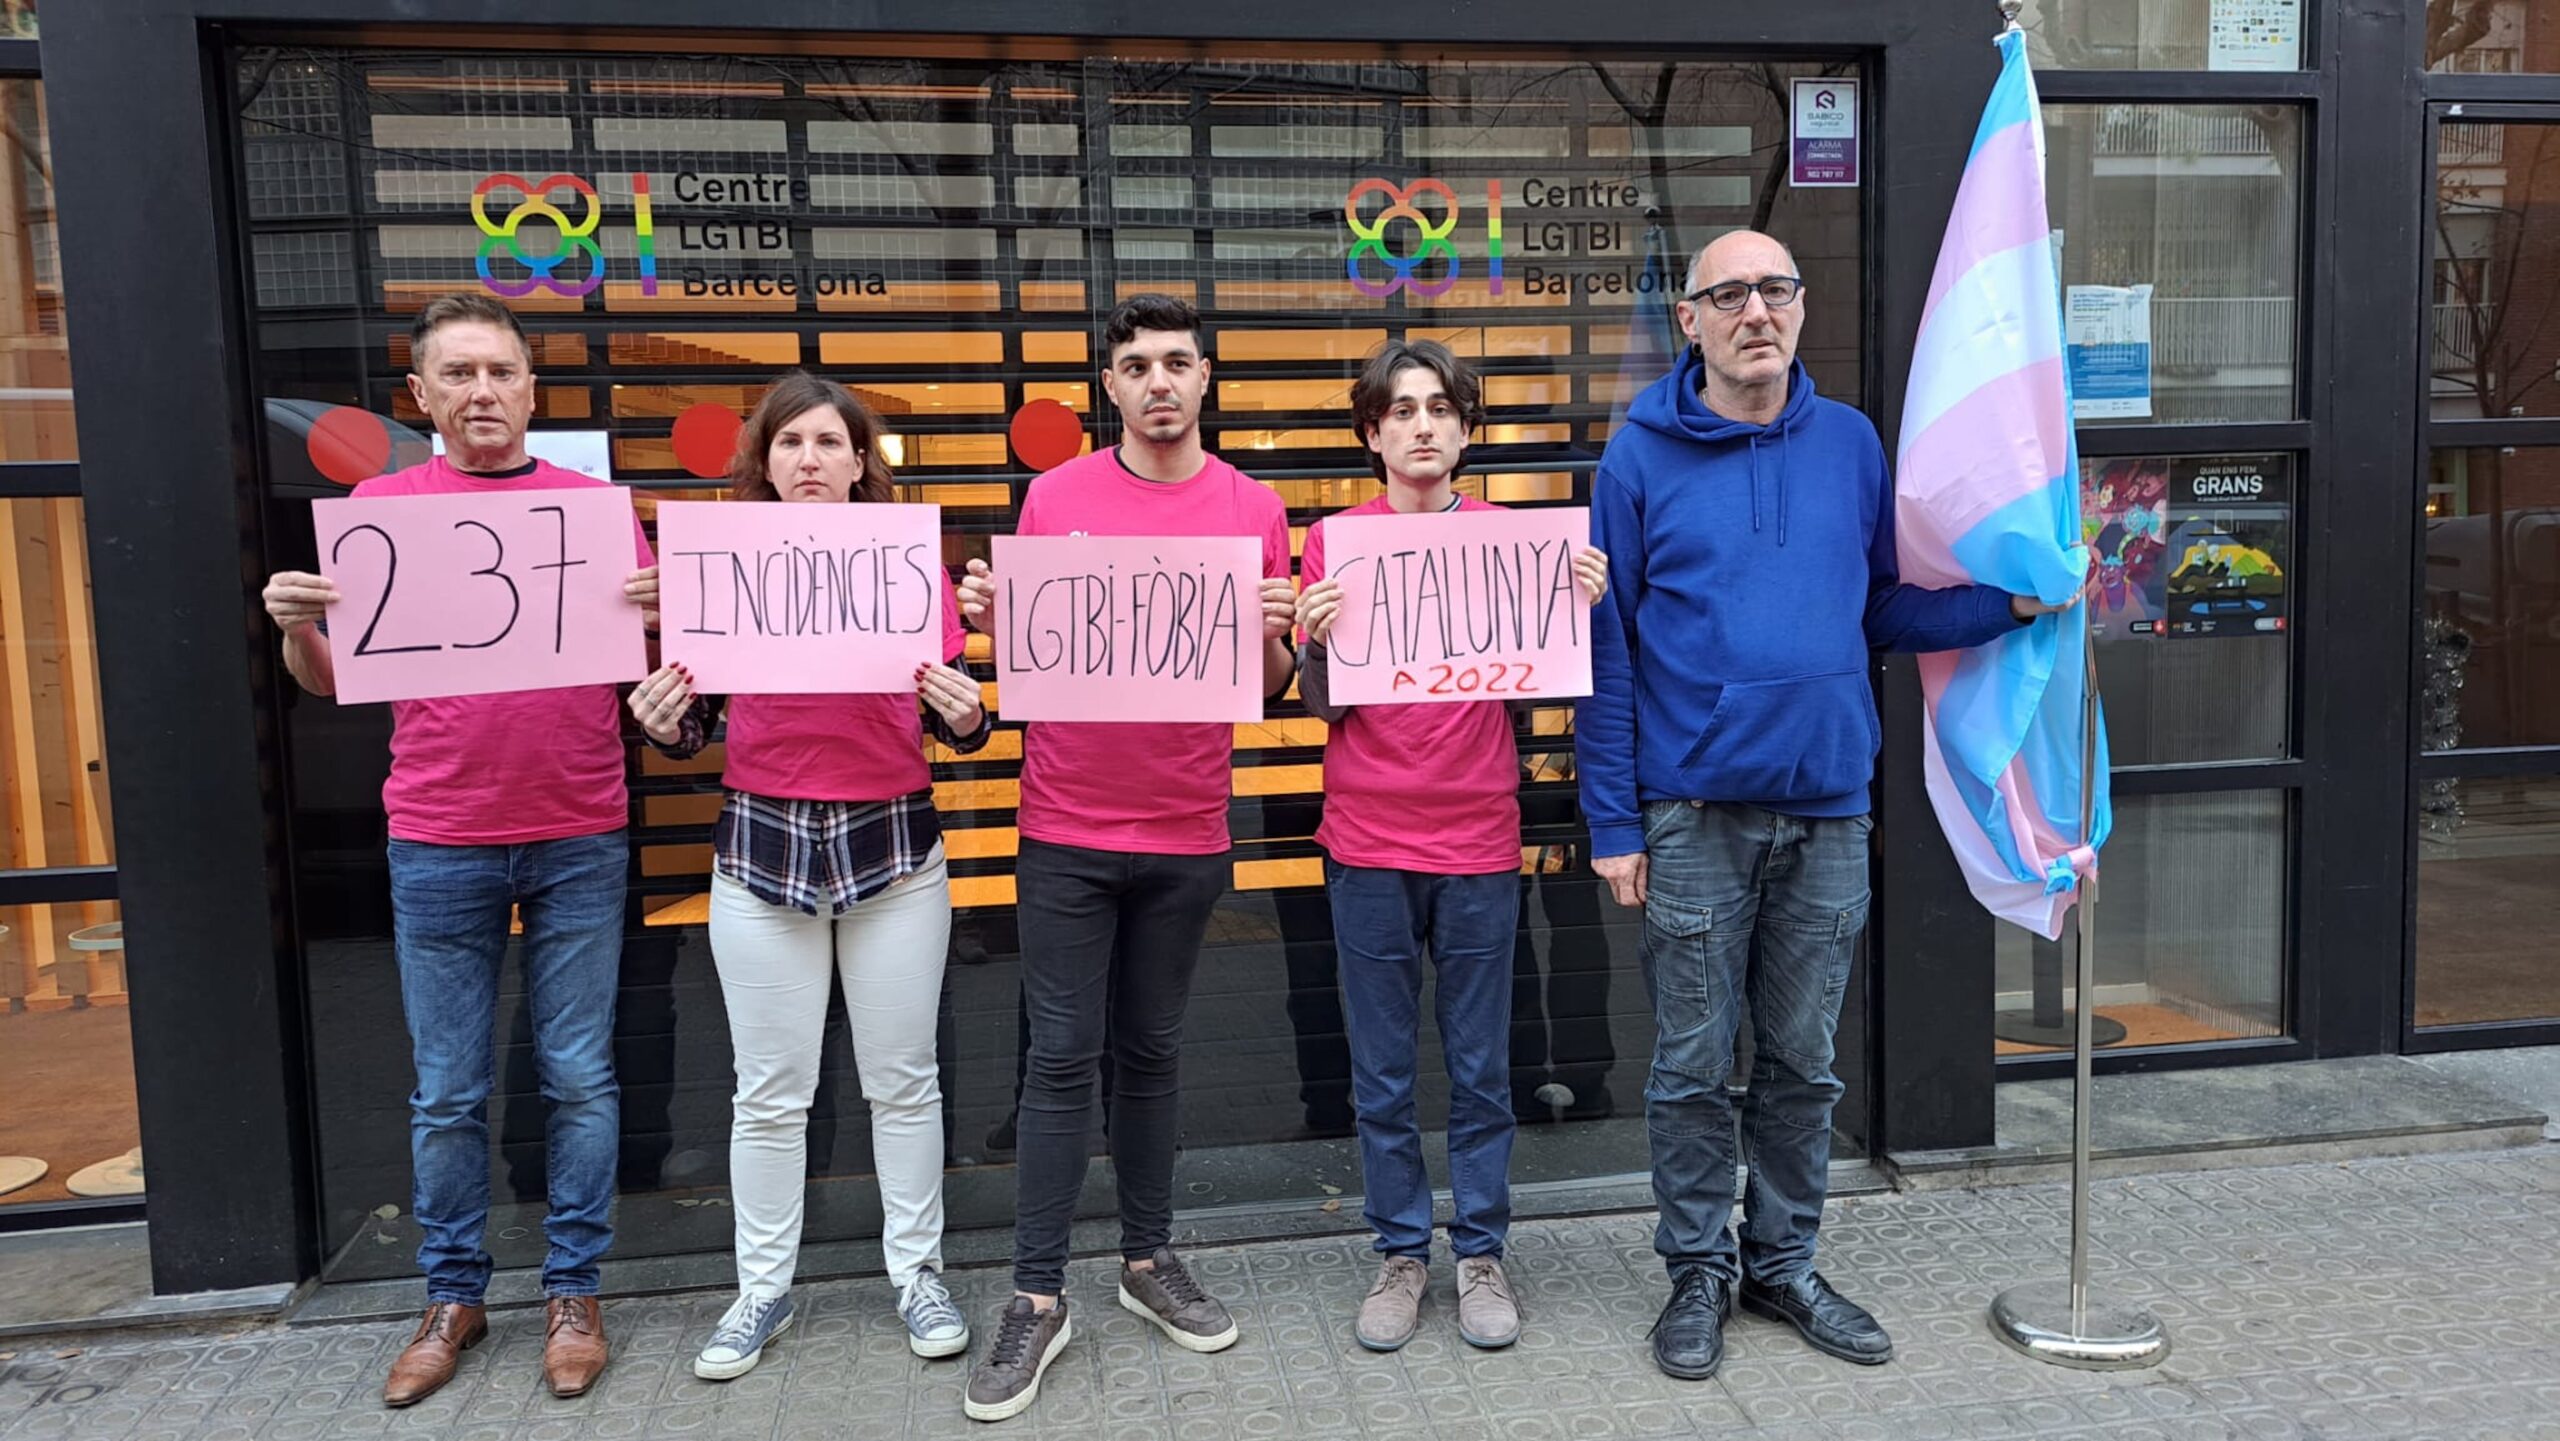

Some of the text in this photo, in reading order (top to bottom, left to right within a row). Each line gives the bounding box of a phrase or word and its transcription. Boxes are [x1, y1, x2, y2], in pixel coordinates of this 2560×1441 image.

[674, 171, 810, 203] Centre
[1522, 178, 1640, 208] Centre
[679, 218, 793, 250] LGTBI
[1523, 221, 1621, 251] LGTBI
[683, 265, 887, 297] Barcelona
[2192, 474, 2263, 496] GRANS
[332, 506, 588, 657] 237
[1328, 538, 1578, 667] CATALUNYA
[1392, 663, 1540, 695] A 2022
